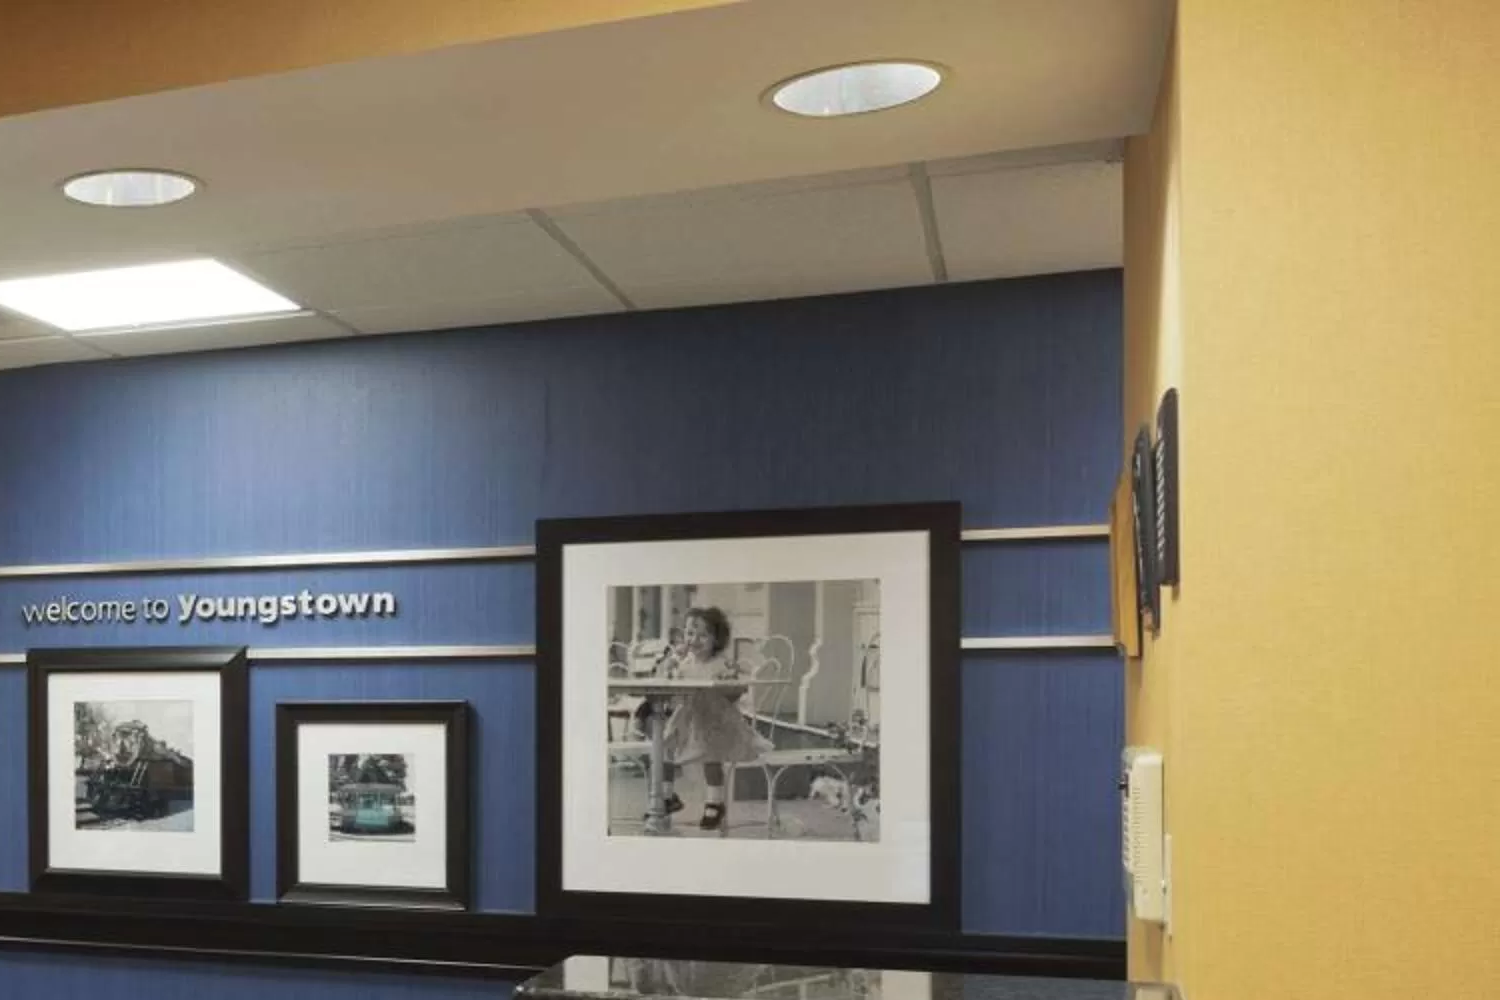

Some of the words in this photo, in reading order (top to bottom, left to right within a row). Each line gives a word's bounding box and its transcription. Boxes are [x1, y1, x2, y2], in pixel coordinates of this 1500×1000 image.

[21, 595, 137, 625] welcome
[143, 595, 170, 622] to
[177, 589, 397, 625] youngstown
